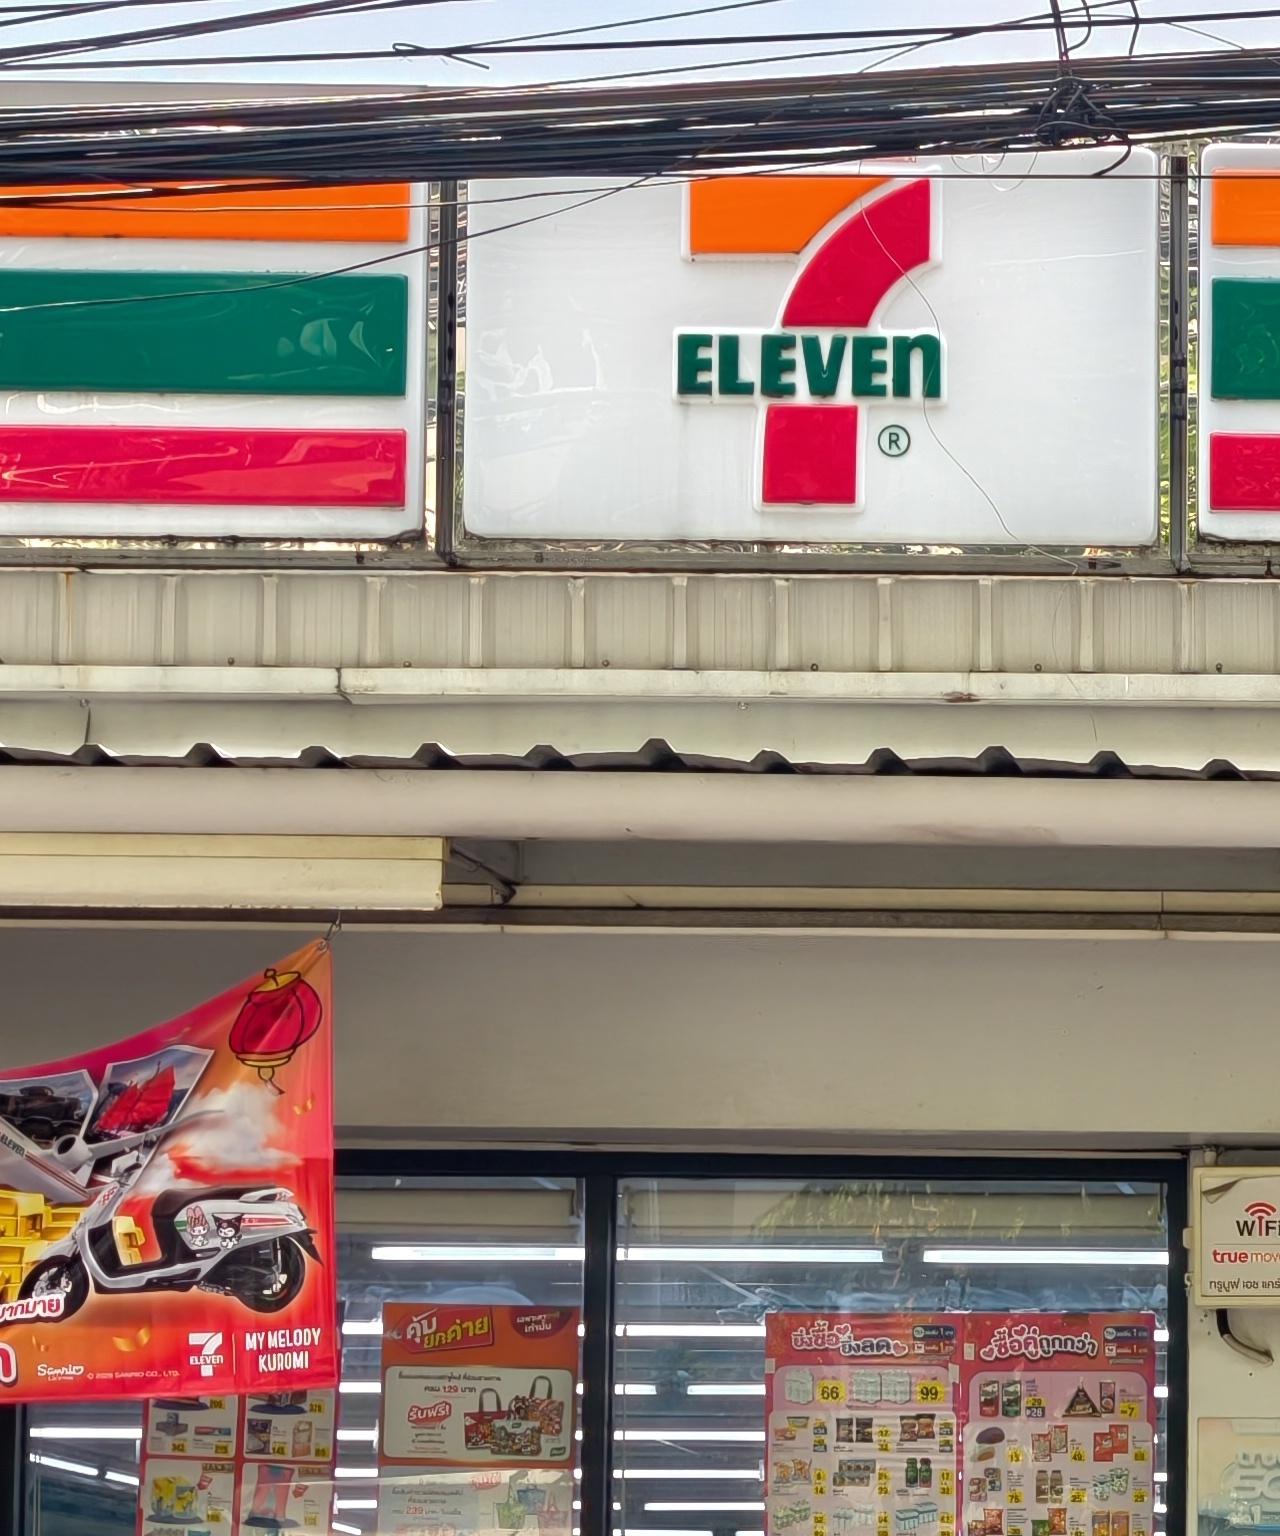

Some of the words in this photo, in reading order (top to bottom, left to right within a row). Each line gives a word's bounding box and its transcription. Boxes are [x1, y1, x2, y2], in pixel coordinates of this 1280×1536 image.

[688, 176, 932, 504] 7
[1212, 1249, 1249, 1263] true
[246, 1331, 265, 1351] MY
[268, 1328, 321, 1349] MELODY
[258, 1351, 309, 1373] KUROMI
[821, 1386, 840, 1400] 66
[920, 1386, 939, 1400] 99
